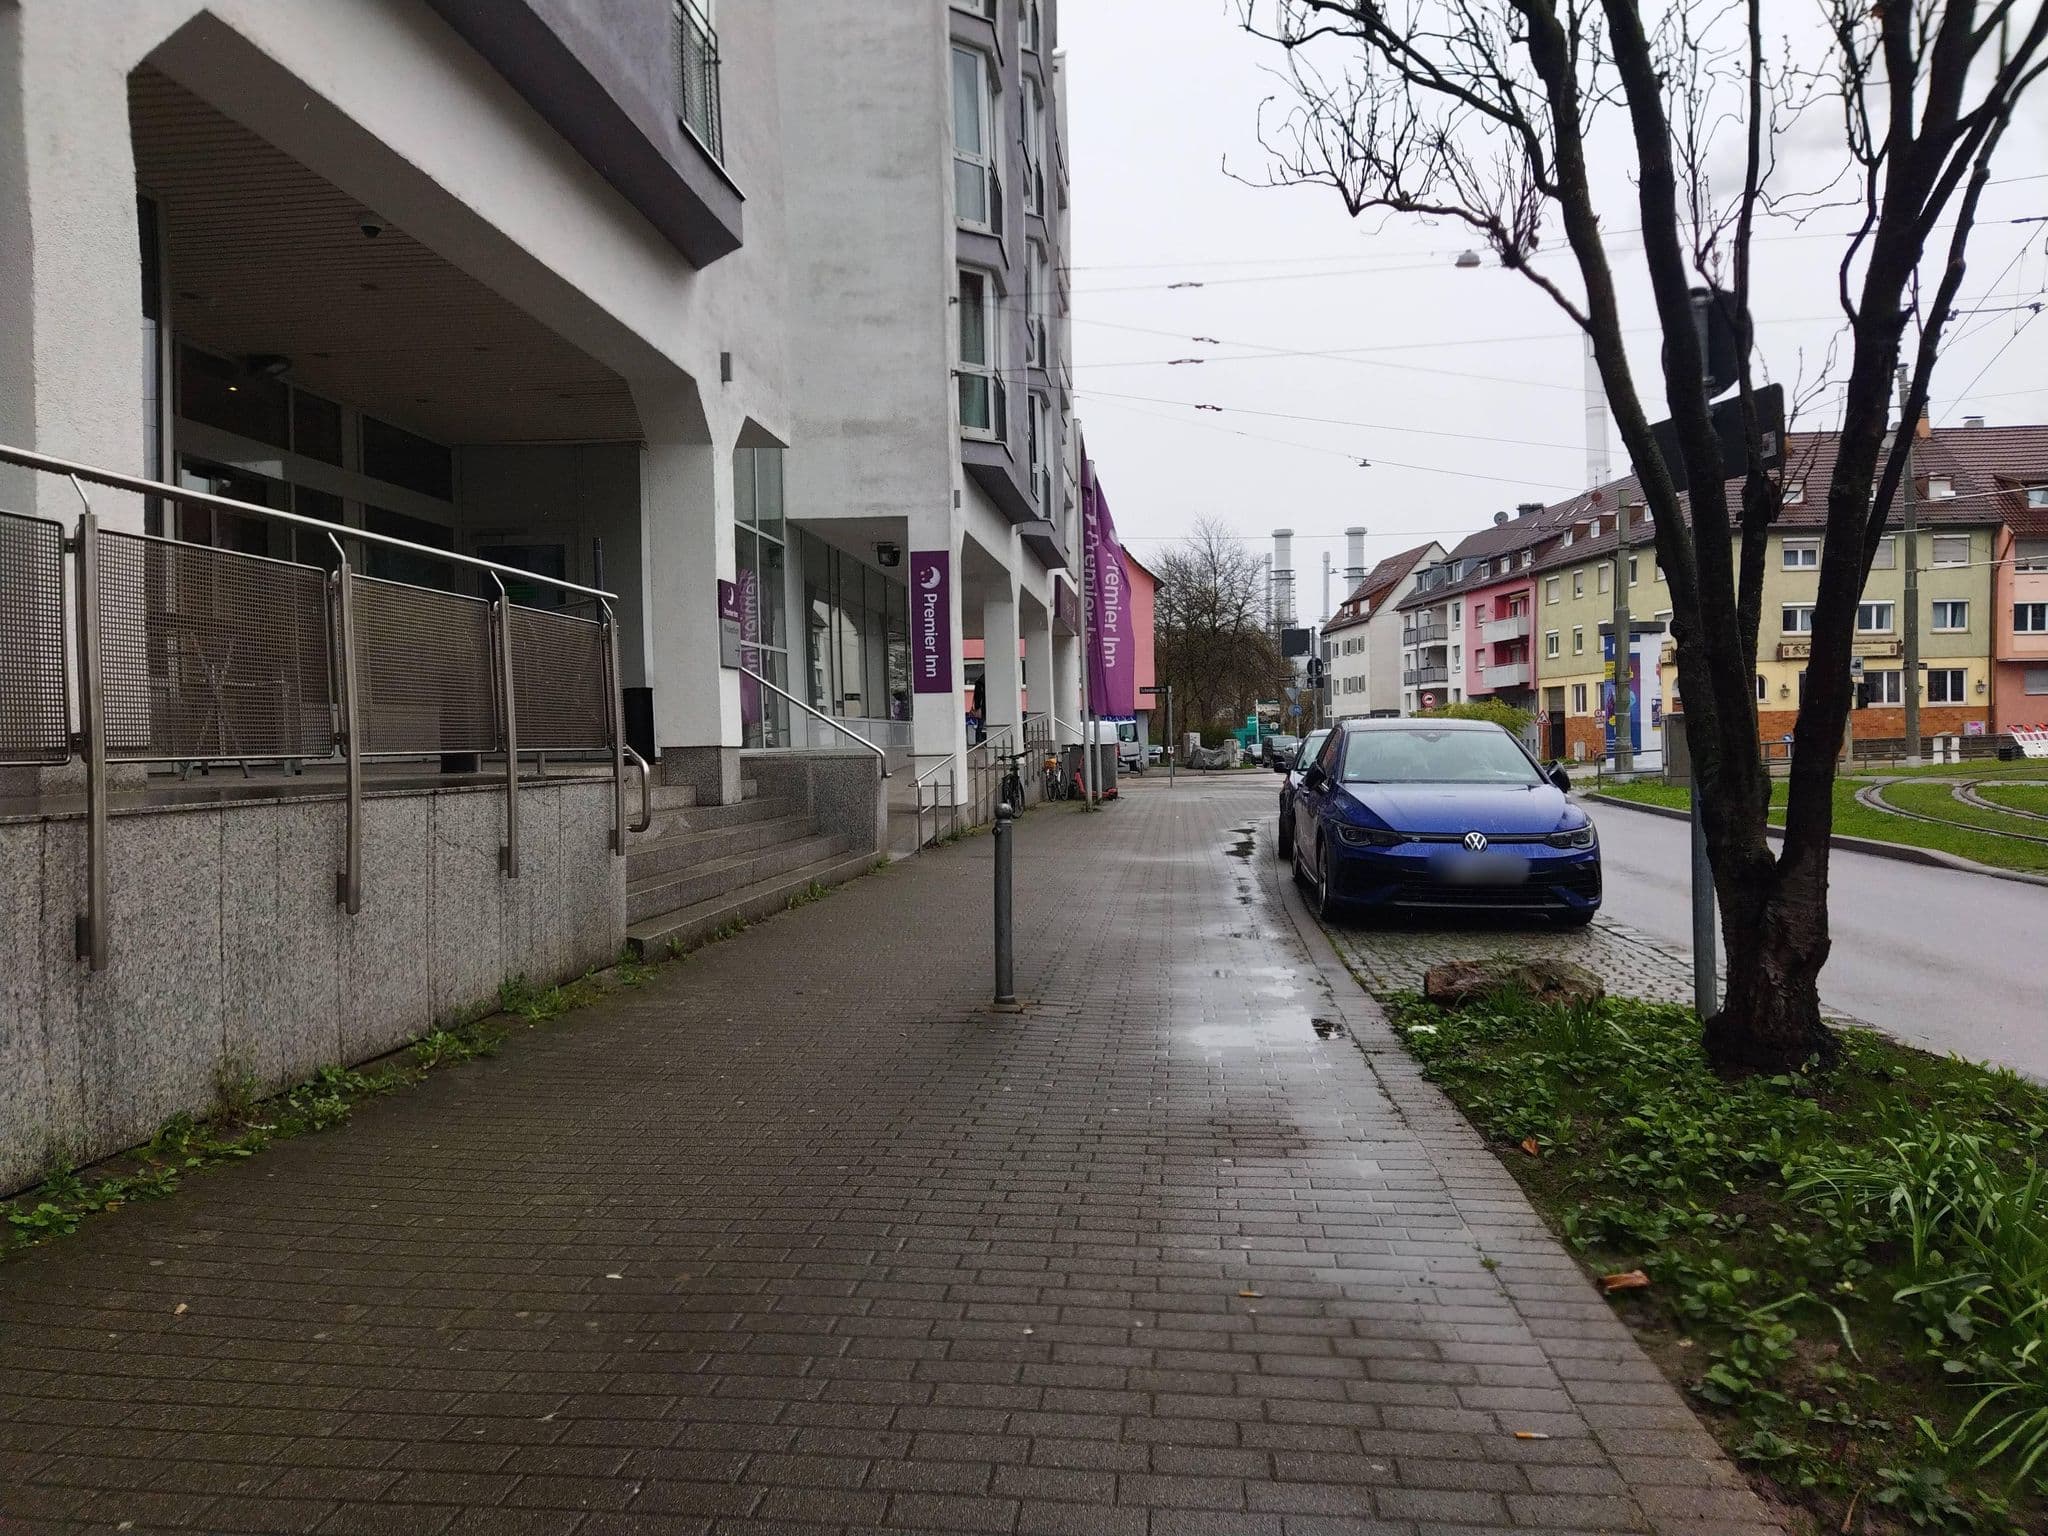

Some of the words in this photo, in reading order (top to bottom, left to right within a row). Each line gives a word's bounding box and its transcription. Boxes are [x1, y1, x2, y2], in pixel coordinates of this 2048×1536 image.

[923, 593, 938, 653] Premier
[1102, 637, 1121, 668] Inn
[925, 655, 939, 678] Inn
[1465, 832, 1487, 851] VW
